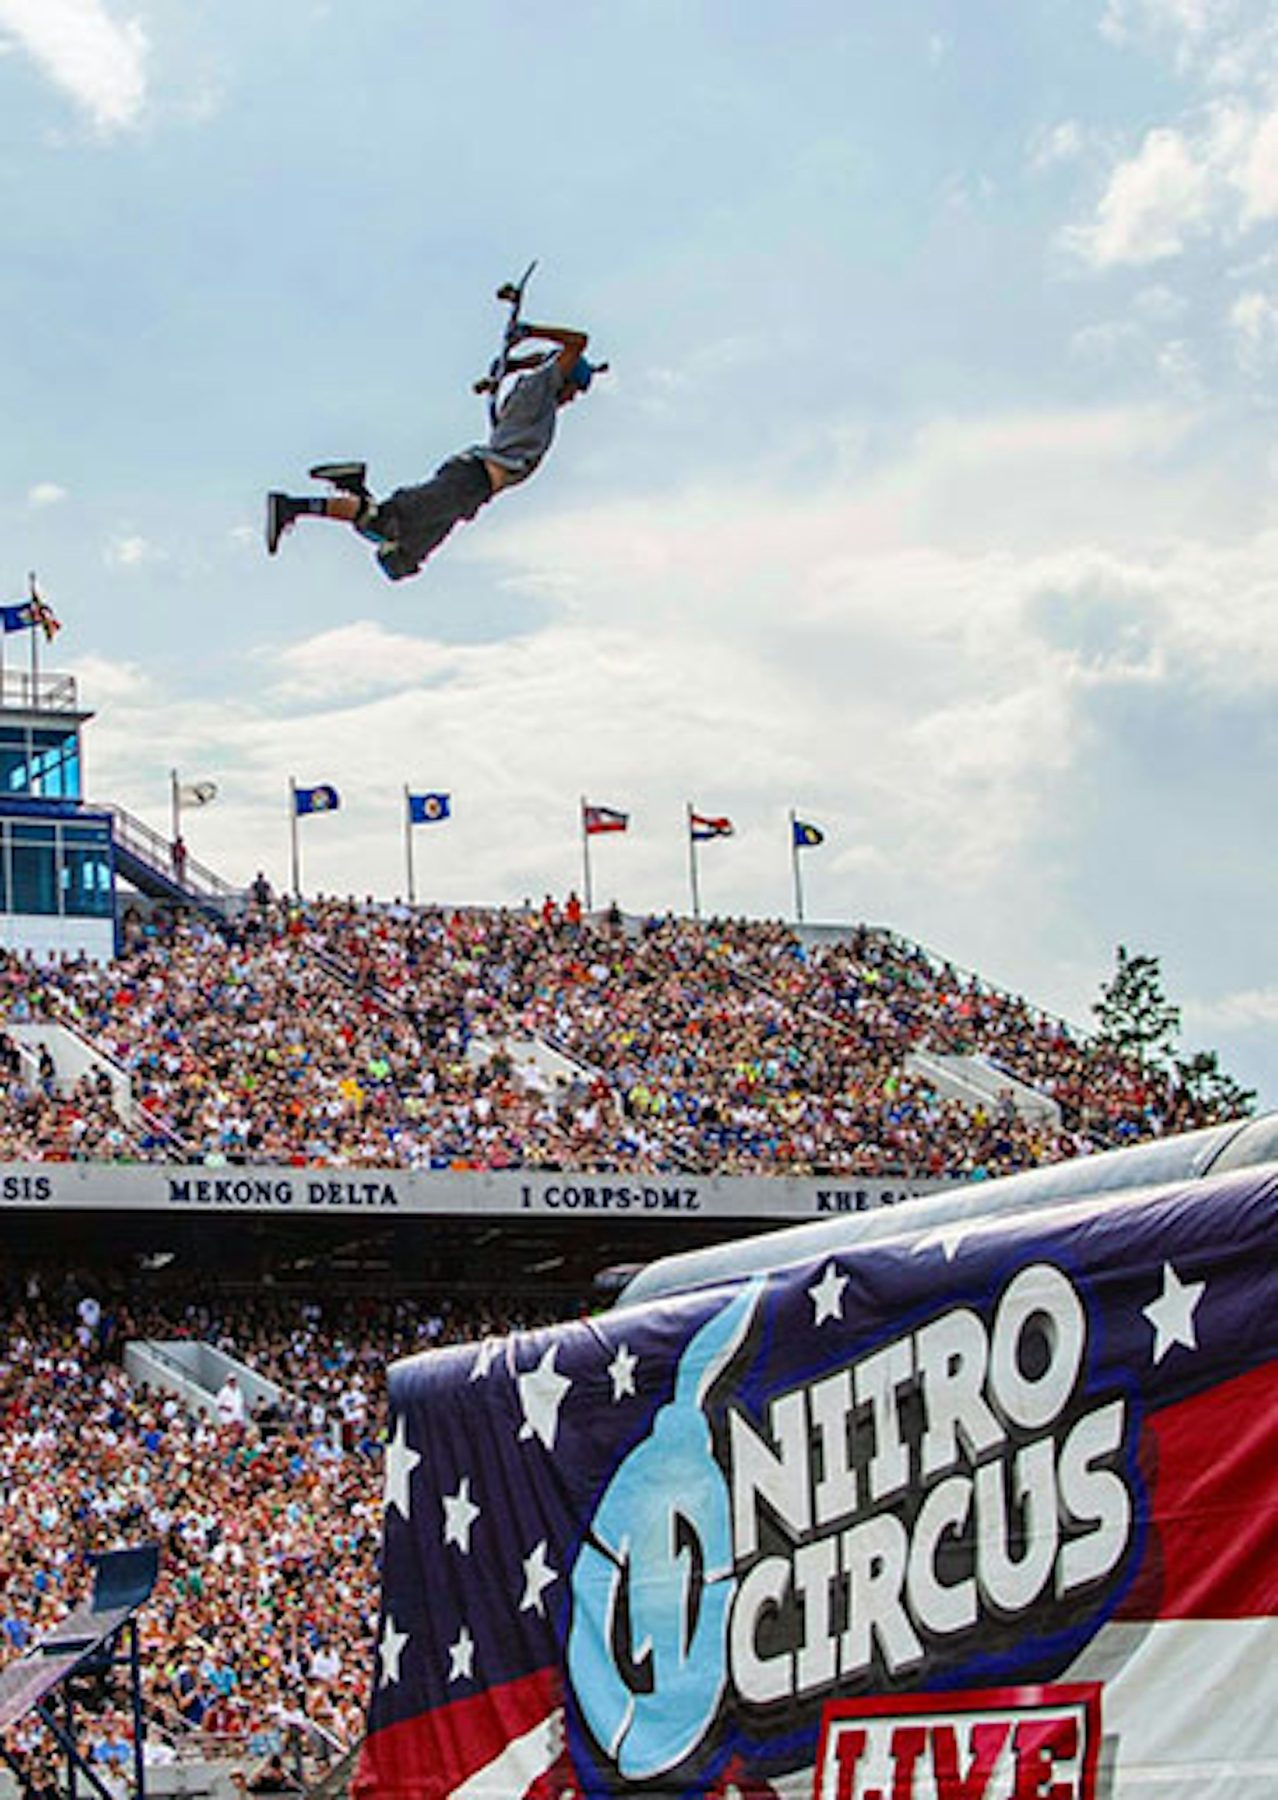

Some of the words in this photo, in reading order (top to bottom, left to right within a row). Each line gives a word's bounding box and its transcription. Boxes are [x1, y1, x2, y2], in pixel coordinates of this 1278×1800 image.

[4, 1176, 52, 1200] SIS
[169, 1180, 293, 1204] MEKONG
[308, 1183, 399, 1206] DELTA
[521, 1186, 532, 1208] I
[545, 1186, 700, 1210] CORPS-DMZ
[816, 1190, 869, 1212] KHE
[728, 1261, 1088, 1560] NITRO
[728, 1399, 1132, 1704] CIRCUS
[834, 1716, 1079, 1800] LIVE
